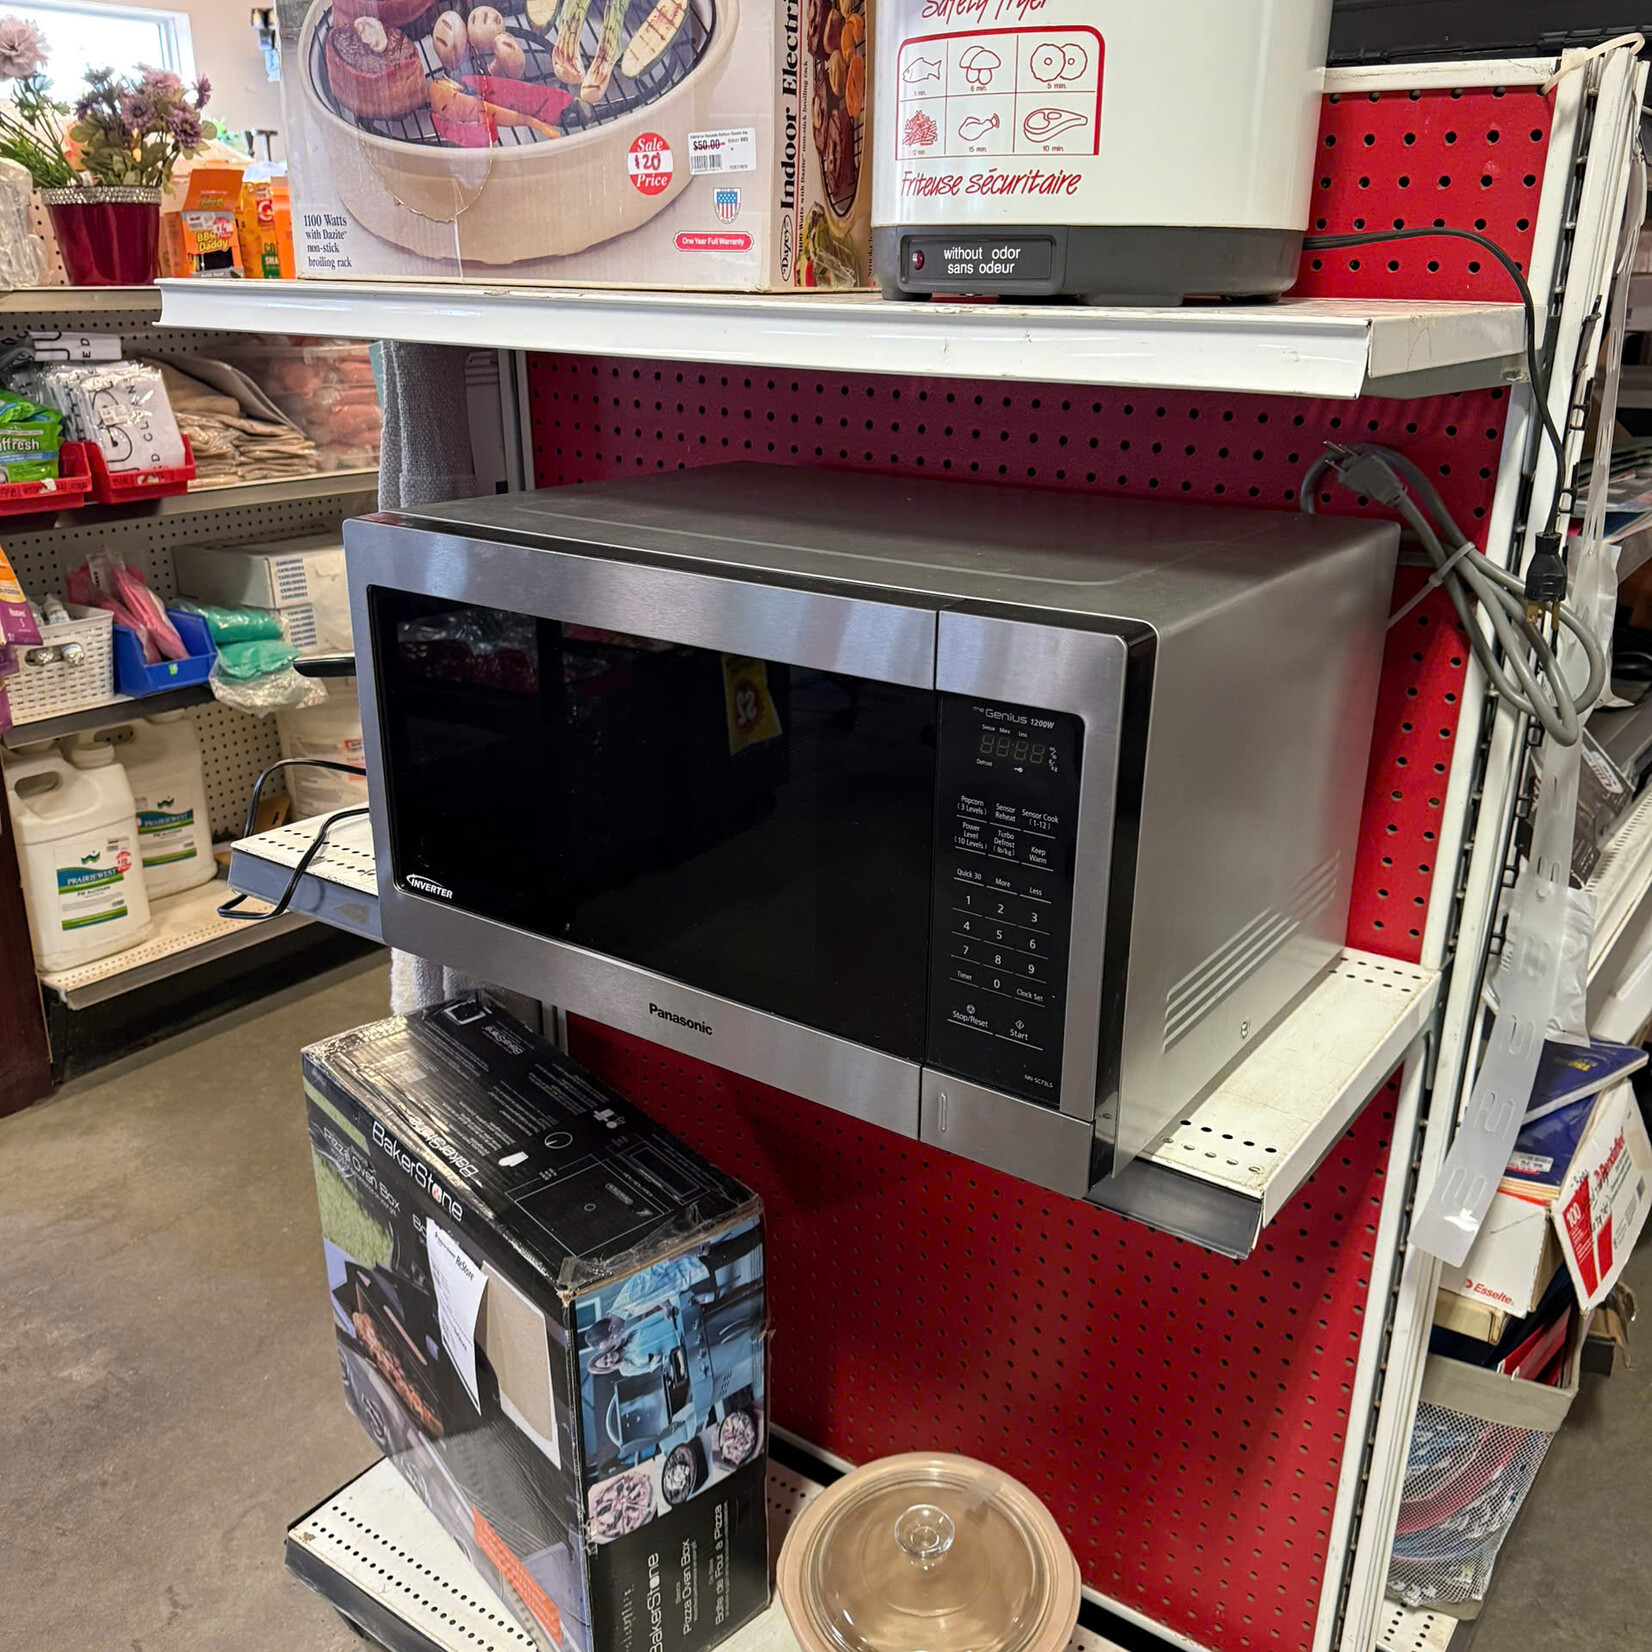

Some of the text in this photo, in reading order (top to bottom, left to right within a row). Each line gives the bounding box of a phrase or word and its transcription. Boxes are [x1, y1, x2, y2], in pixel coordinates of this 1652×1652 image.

[637, 138, 663, 152] Sale
[693, 139, 720, 151] $50.00
[780, 107, 798, 211] Indoor
[636, 174, 668, 187] Price
[900, 168, 1082, 197] Friteuse sécuritaire
[304, 214, 347, 227] 1100 Watts
[305, 229, 321, 240] with
[199, 240, 228, 252] Daddy
[307, 242, 340, 253] non-stick
[682, 237, 745, 247] One Year Full Warranty
[944, 246, 1020, 260] without odor
[308, 256, 352, 270] broiling rack
[947, 261, 1015, 274] sans odeur
[985, 708, 1028, 725] Genius
[1030, 718, 1055, 729] 1200W
[961, 795, 984, 807] Popcorn
[995, 803, 1016, 814] Sensor
[995, 811, 1016, 823] Reheat
[1022, 808, 1059, 824] Sensor Cook
[962, 821, 981, 832] Power
[963, 830, 979, 840] Level
[997, 830, 1015, 840] Turbo
[994, 838, 1015, 849] Defrost
[1031, 846, 1047, 857] Keep
[1029, 854, 1047, 865] Warm
[956, 868, 983, 880] Quick 30
[410, 878, 453, 900] INVERTER
[995, 878, 1011, 888] More
[1029, 886, 1043, 896] Less
[965, 895, 971, 905] 1
[997, 903, 1004, 914] 2
[1030, 912, 1038, 923] 3
[963, 920, 970, 931] 4
[996, 929, 1003, 940] 5
[1029, 938, 1036, 949] 6
[963, 945, 969, 955] 7
[994, 954, 1002, 965] 8
[1027, 963, 1035, 974] 9
[957, 970, 973, 981] Timer
[993, 978, 1001, 989] 0
[1016, 988, 1044, 1002] Clock Set
[649, 1002, 714, 1036] Panasonic
[952, 1010, 989, 1028] Stop/Reset
[1010, 1028, 1029, 1041] Start
[351, 1155, 378, 1190] Oven
[372, 1120, 464, 1222] BakerStone
[1565, 1202, 1583, 1228] 100
[714, 1503, 723, 1540] Pizza
[715, 1552, 724, 1578] Four
[681, 1538, 692, 1635] Pizza Oven Box
